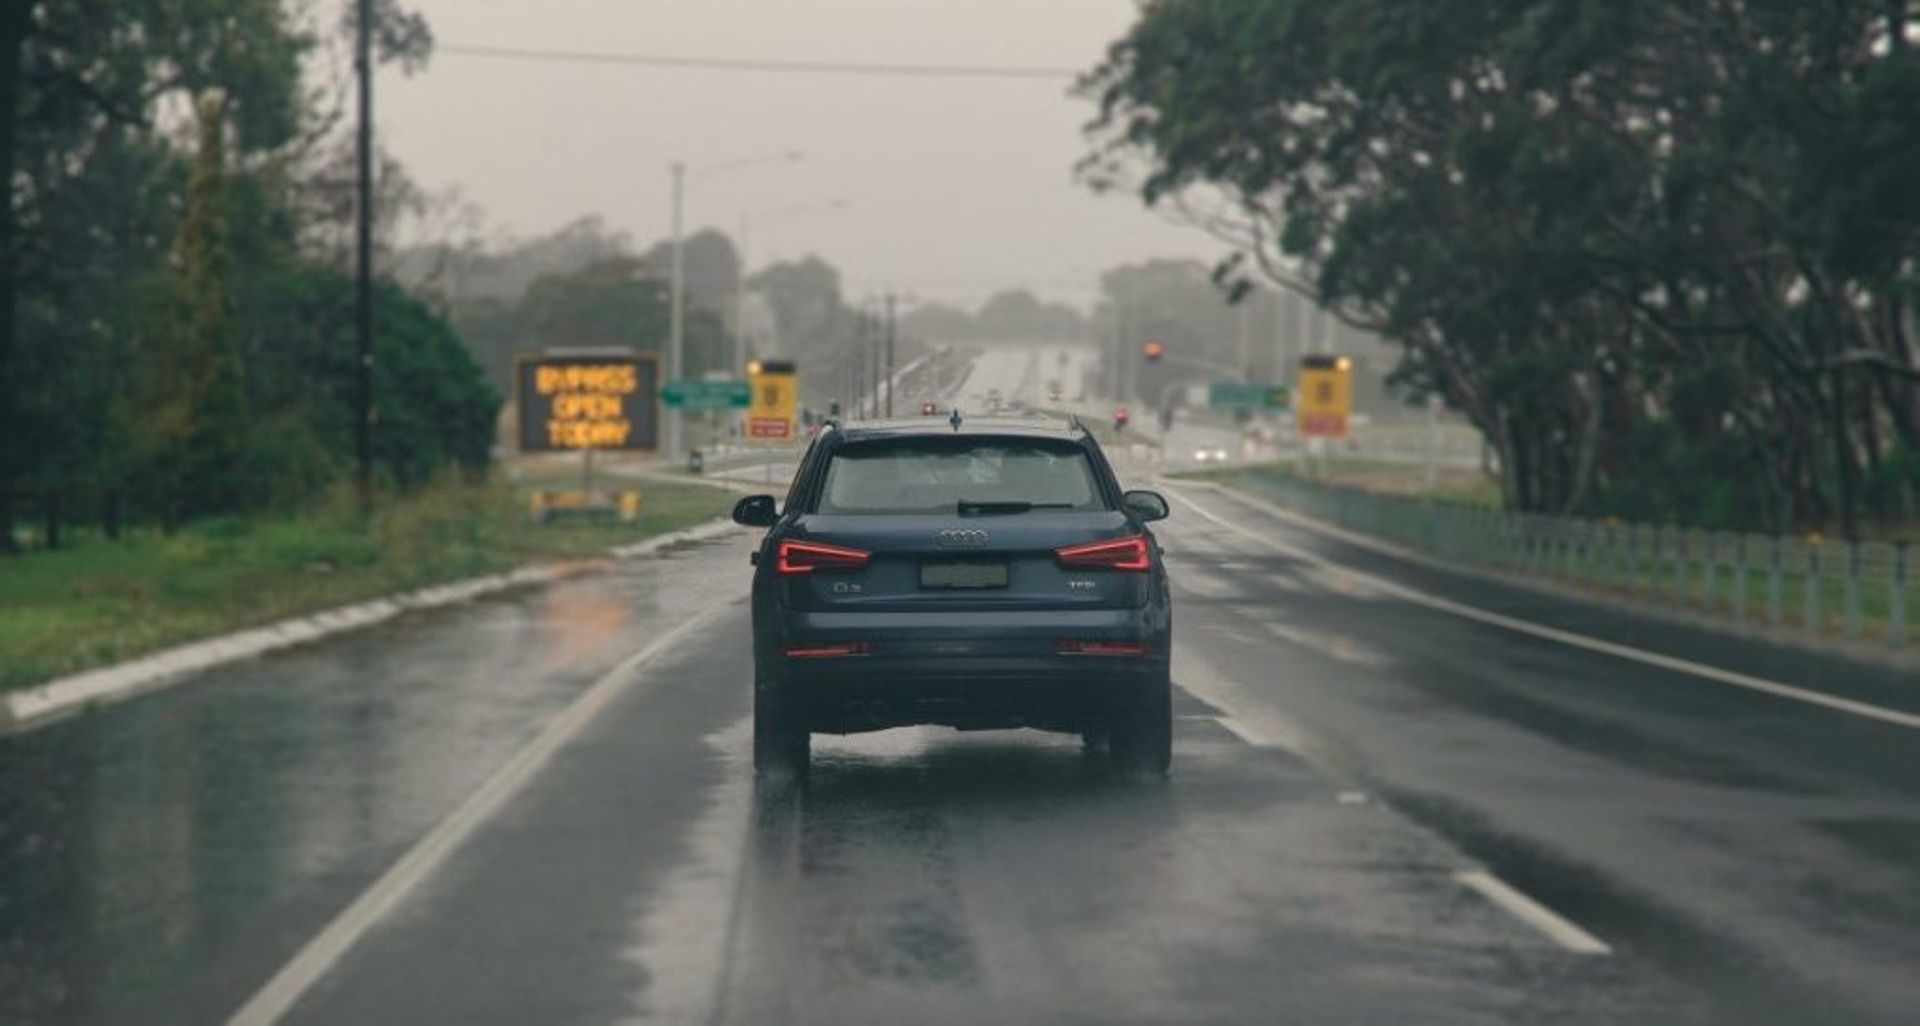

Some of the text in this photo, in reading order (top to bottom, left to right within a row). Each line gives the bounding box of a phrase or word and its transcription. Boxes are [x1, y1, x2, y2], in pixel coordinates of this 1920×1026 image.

[536, 365, 636, 394] BYPASS
[552, 395, 621, 419] OPEN
[549, 420, 630, 448] TODAY
